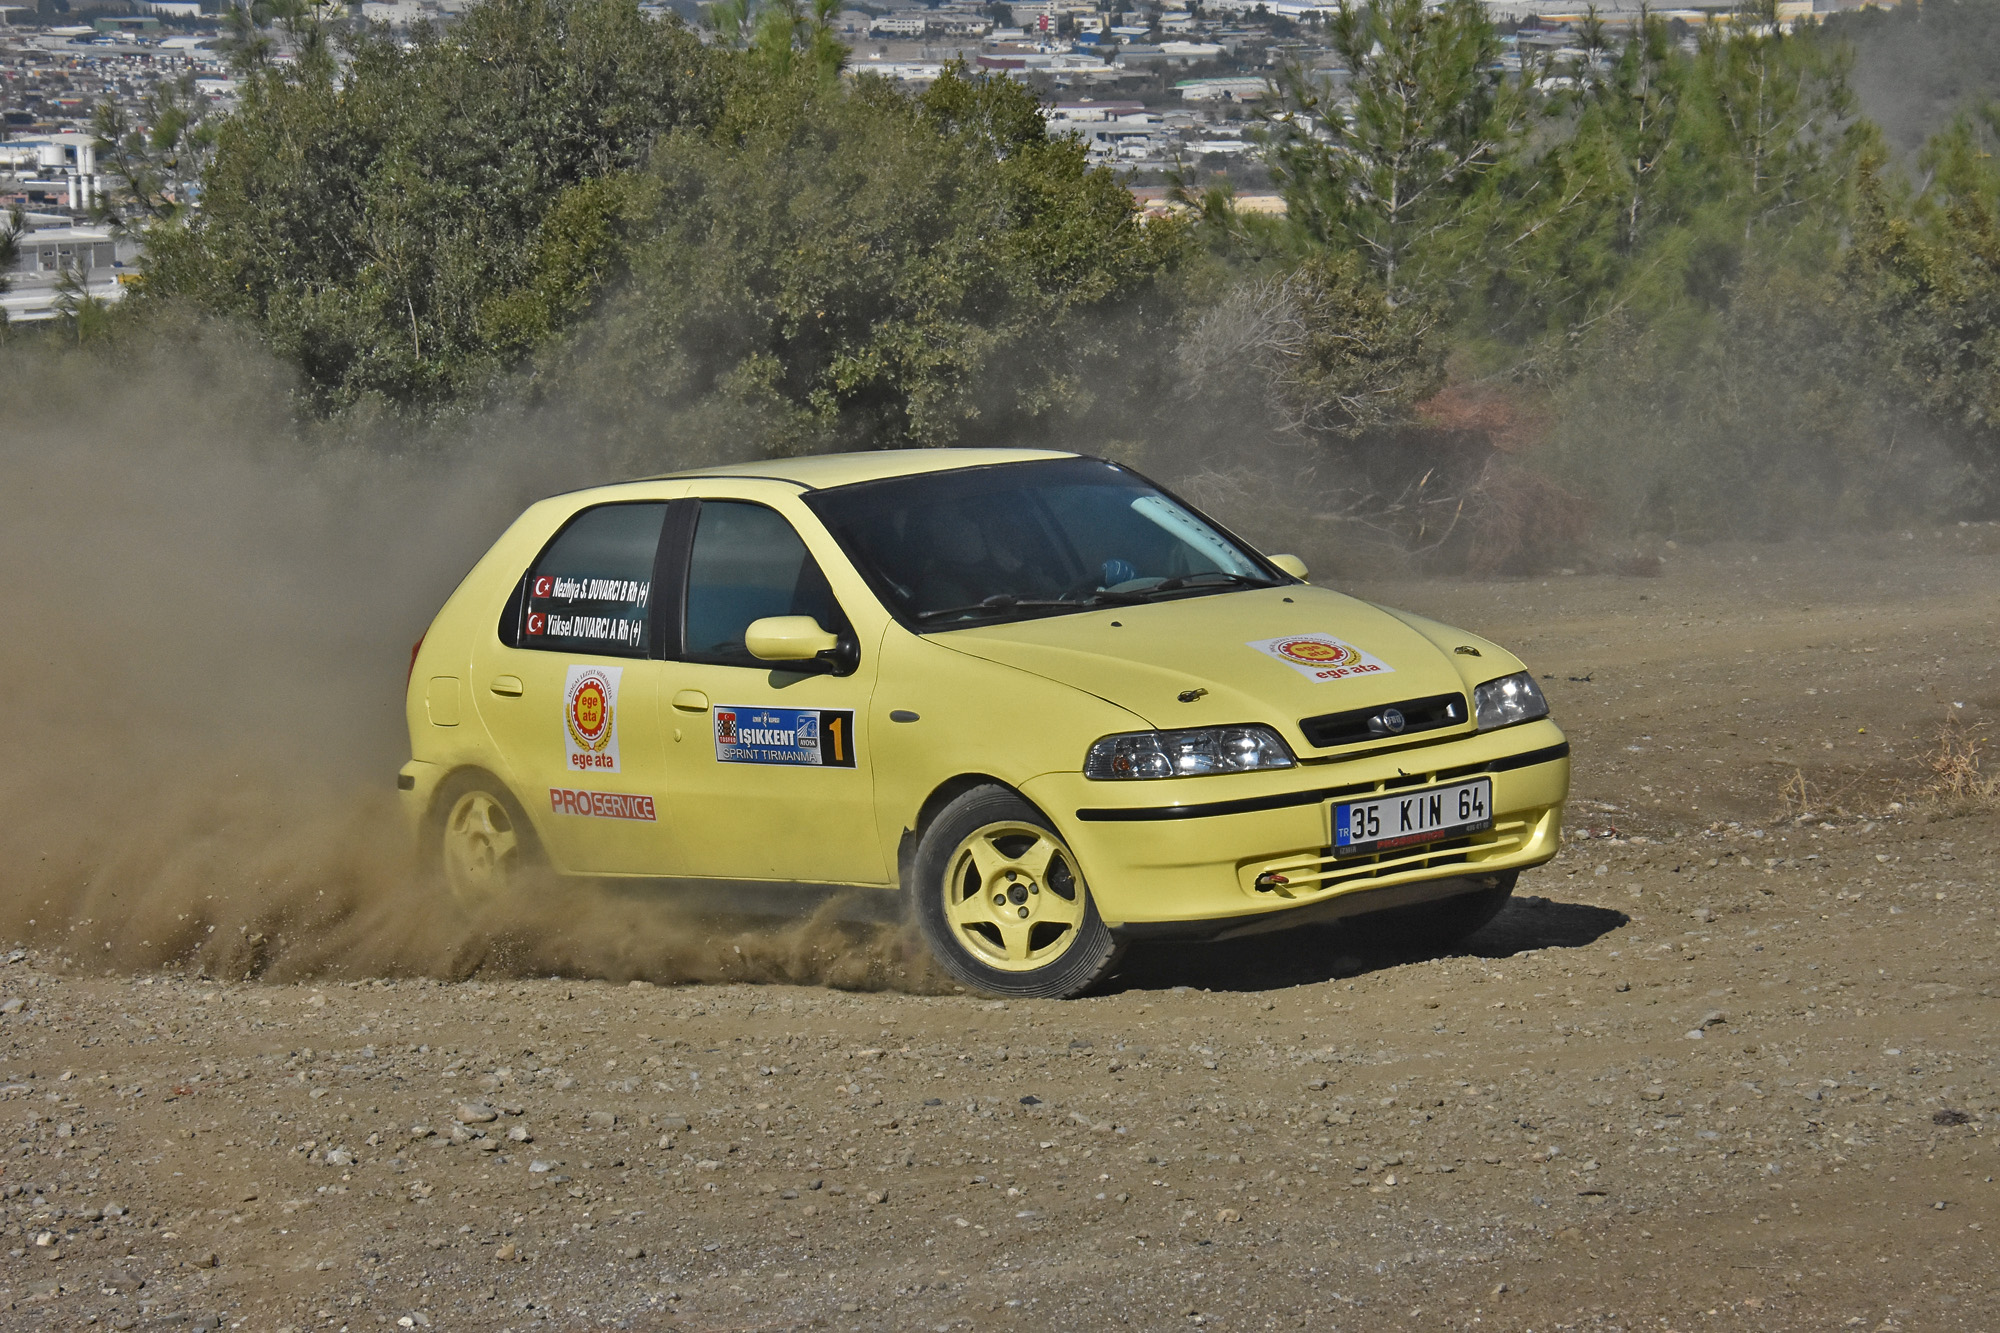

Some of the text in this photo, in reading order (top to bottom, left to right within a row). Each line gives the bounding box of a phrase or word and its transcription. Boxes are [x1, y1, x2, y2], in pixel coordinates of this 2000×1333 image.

[587, 578, 621, 600] DUVARCI
[620, 580, 629, 602] B
[625, 581, 638, 602] Rh
[636, 581, 650, 608] (+)
[546, 614, 642, 647] Yüksel DUVARCI A Rh (+)
[1316, 664, 1381, 679] ege ata
[581, 696, 598, 709] ege
[582, 710, 597, 722] ata
[738, 727, 795, 748] IŞIKKENT
[828, 717, 844, 761] 1
[571, 752, 614, 770] ege ata
[723, 748, 817, 761] SPRINT TIRMANMA
[1351, 786, 1484, 840] 35 KIN 64
[1338, 827, 1350, 838] TR
